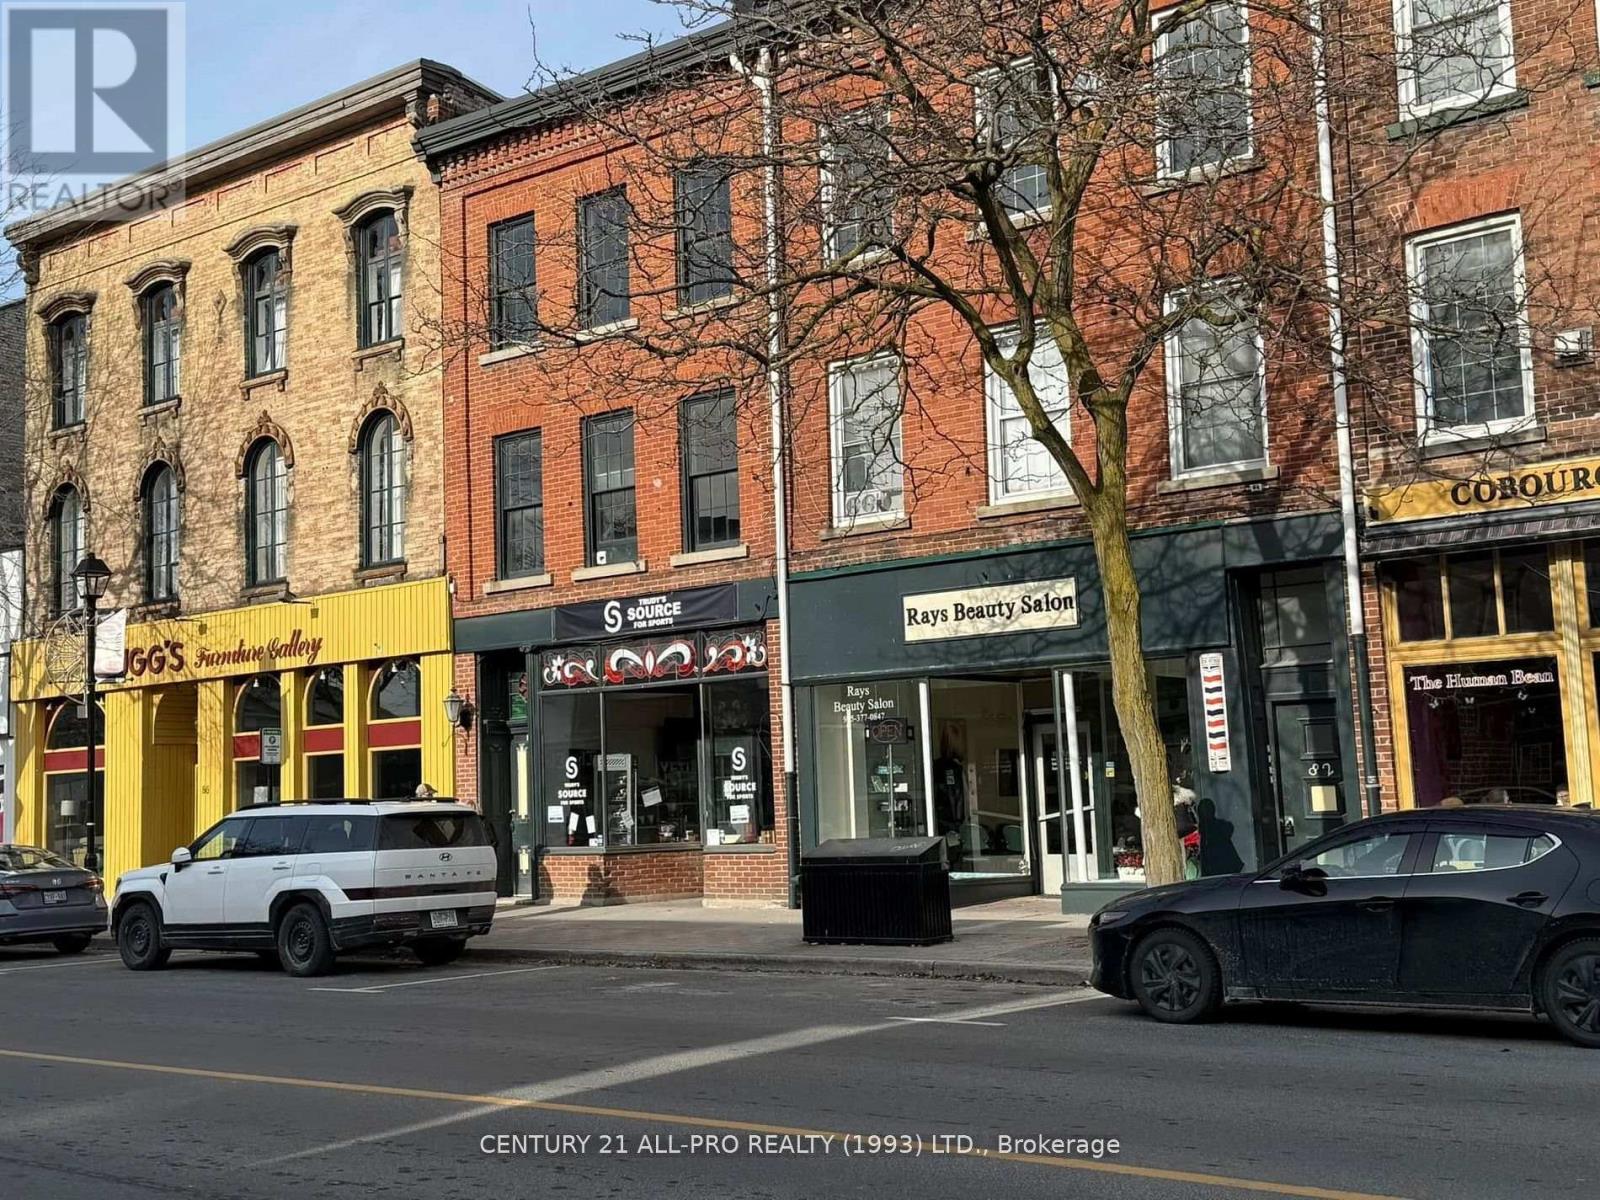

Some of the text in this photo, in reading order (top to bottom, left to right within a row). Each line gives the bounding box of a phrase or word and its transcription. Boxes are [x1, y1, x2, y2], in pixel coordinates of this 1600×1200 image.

[627, 601, 682, 621] SOURCE
[906, 593, 1074, 627] Rays Beauty Salon
[633, 617, 674, 629] FOR SPORTS
[124, 639, 185, 676] GG'S
[194, 639, 264, 669] Furniture
[268, 629, 323, 665] Gallery
[1410, 669, 1554, 691] The Human Bean
[847, 685, 870, 699] Rays
[833, 697, 894, 713] Beauty Salon
[1308, 763, 1334, 777] 82
[558, 789, 587, 798] SOURCE
